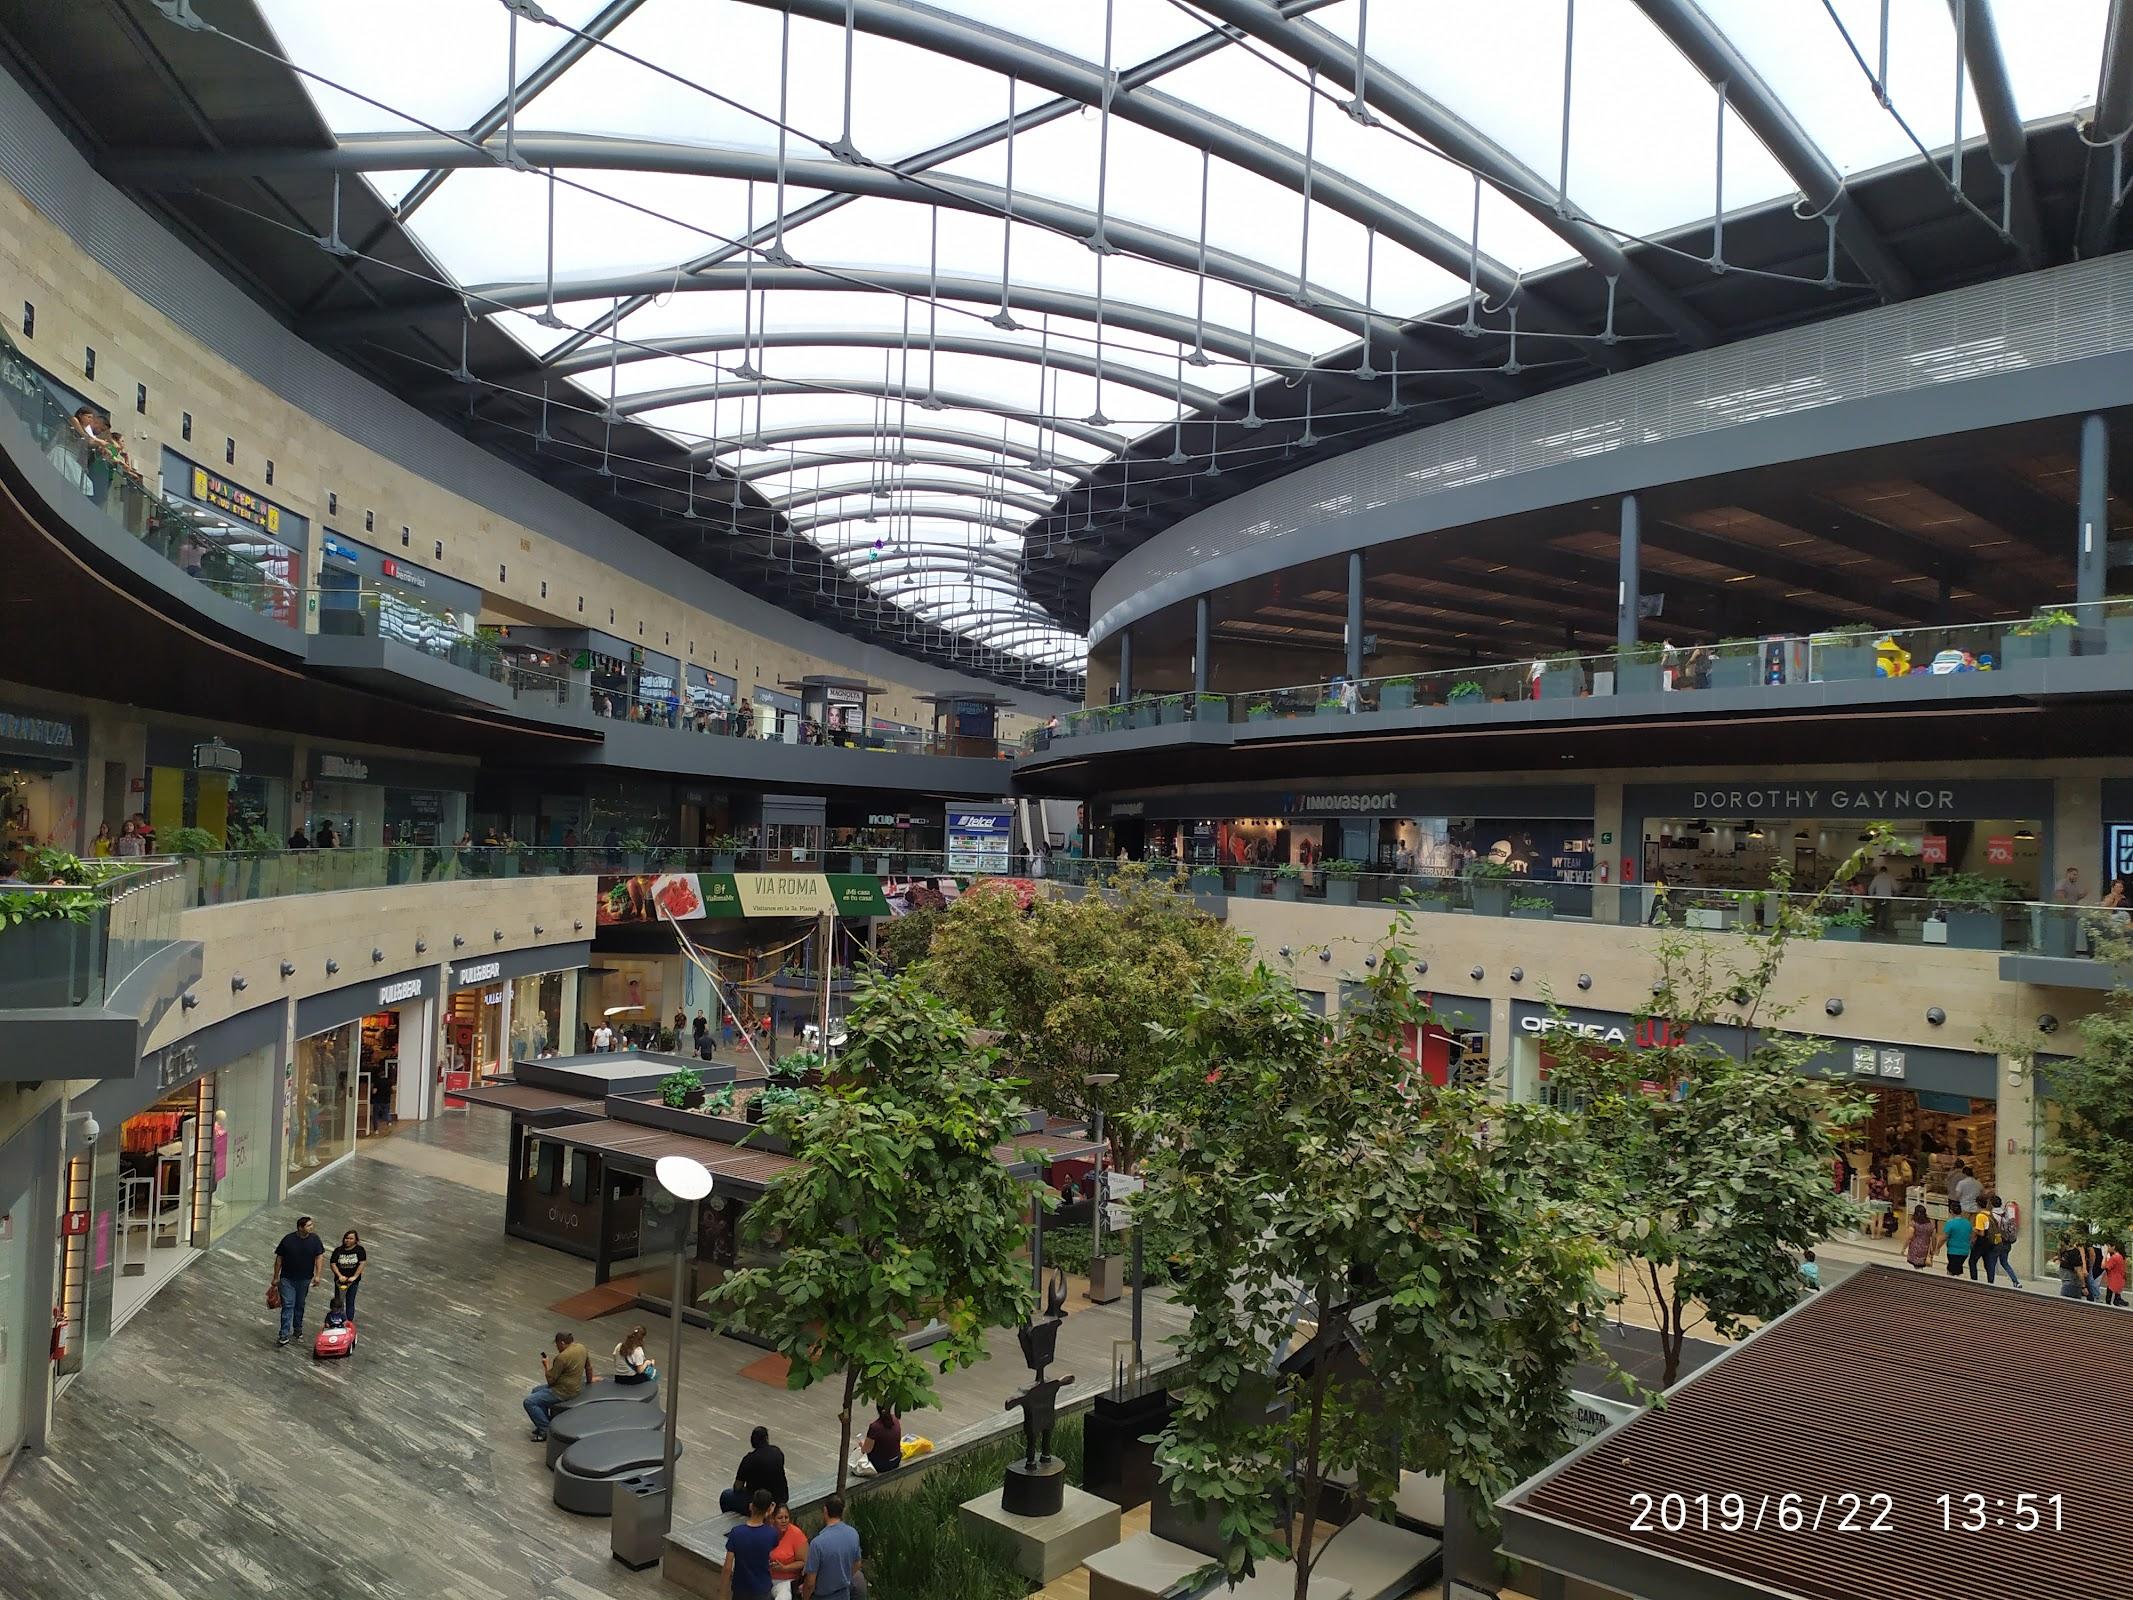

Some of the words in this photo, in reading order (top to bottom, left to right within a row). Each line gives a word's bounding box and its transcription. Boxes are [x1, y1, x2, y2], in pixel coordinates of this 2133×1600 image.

[1693, 790, 1819, 809] DOROTHY
[1831, 790, 1954, 809] GAYNOR
[967, 816, 997, 828] telcel
[755, 878, 774, 894] VIA
[778, 878, 817, 895] ROMA
[459, 962, 500, 985] PULL&BEAR
[379, 979, 422, 1005] PULL&BEAR
[1521, 1016, 1626, 1043] OPTICA
